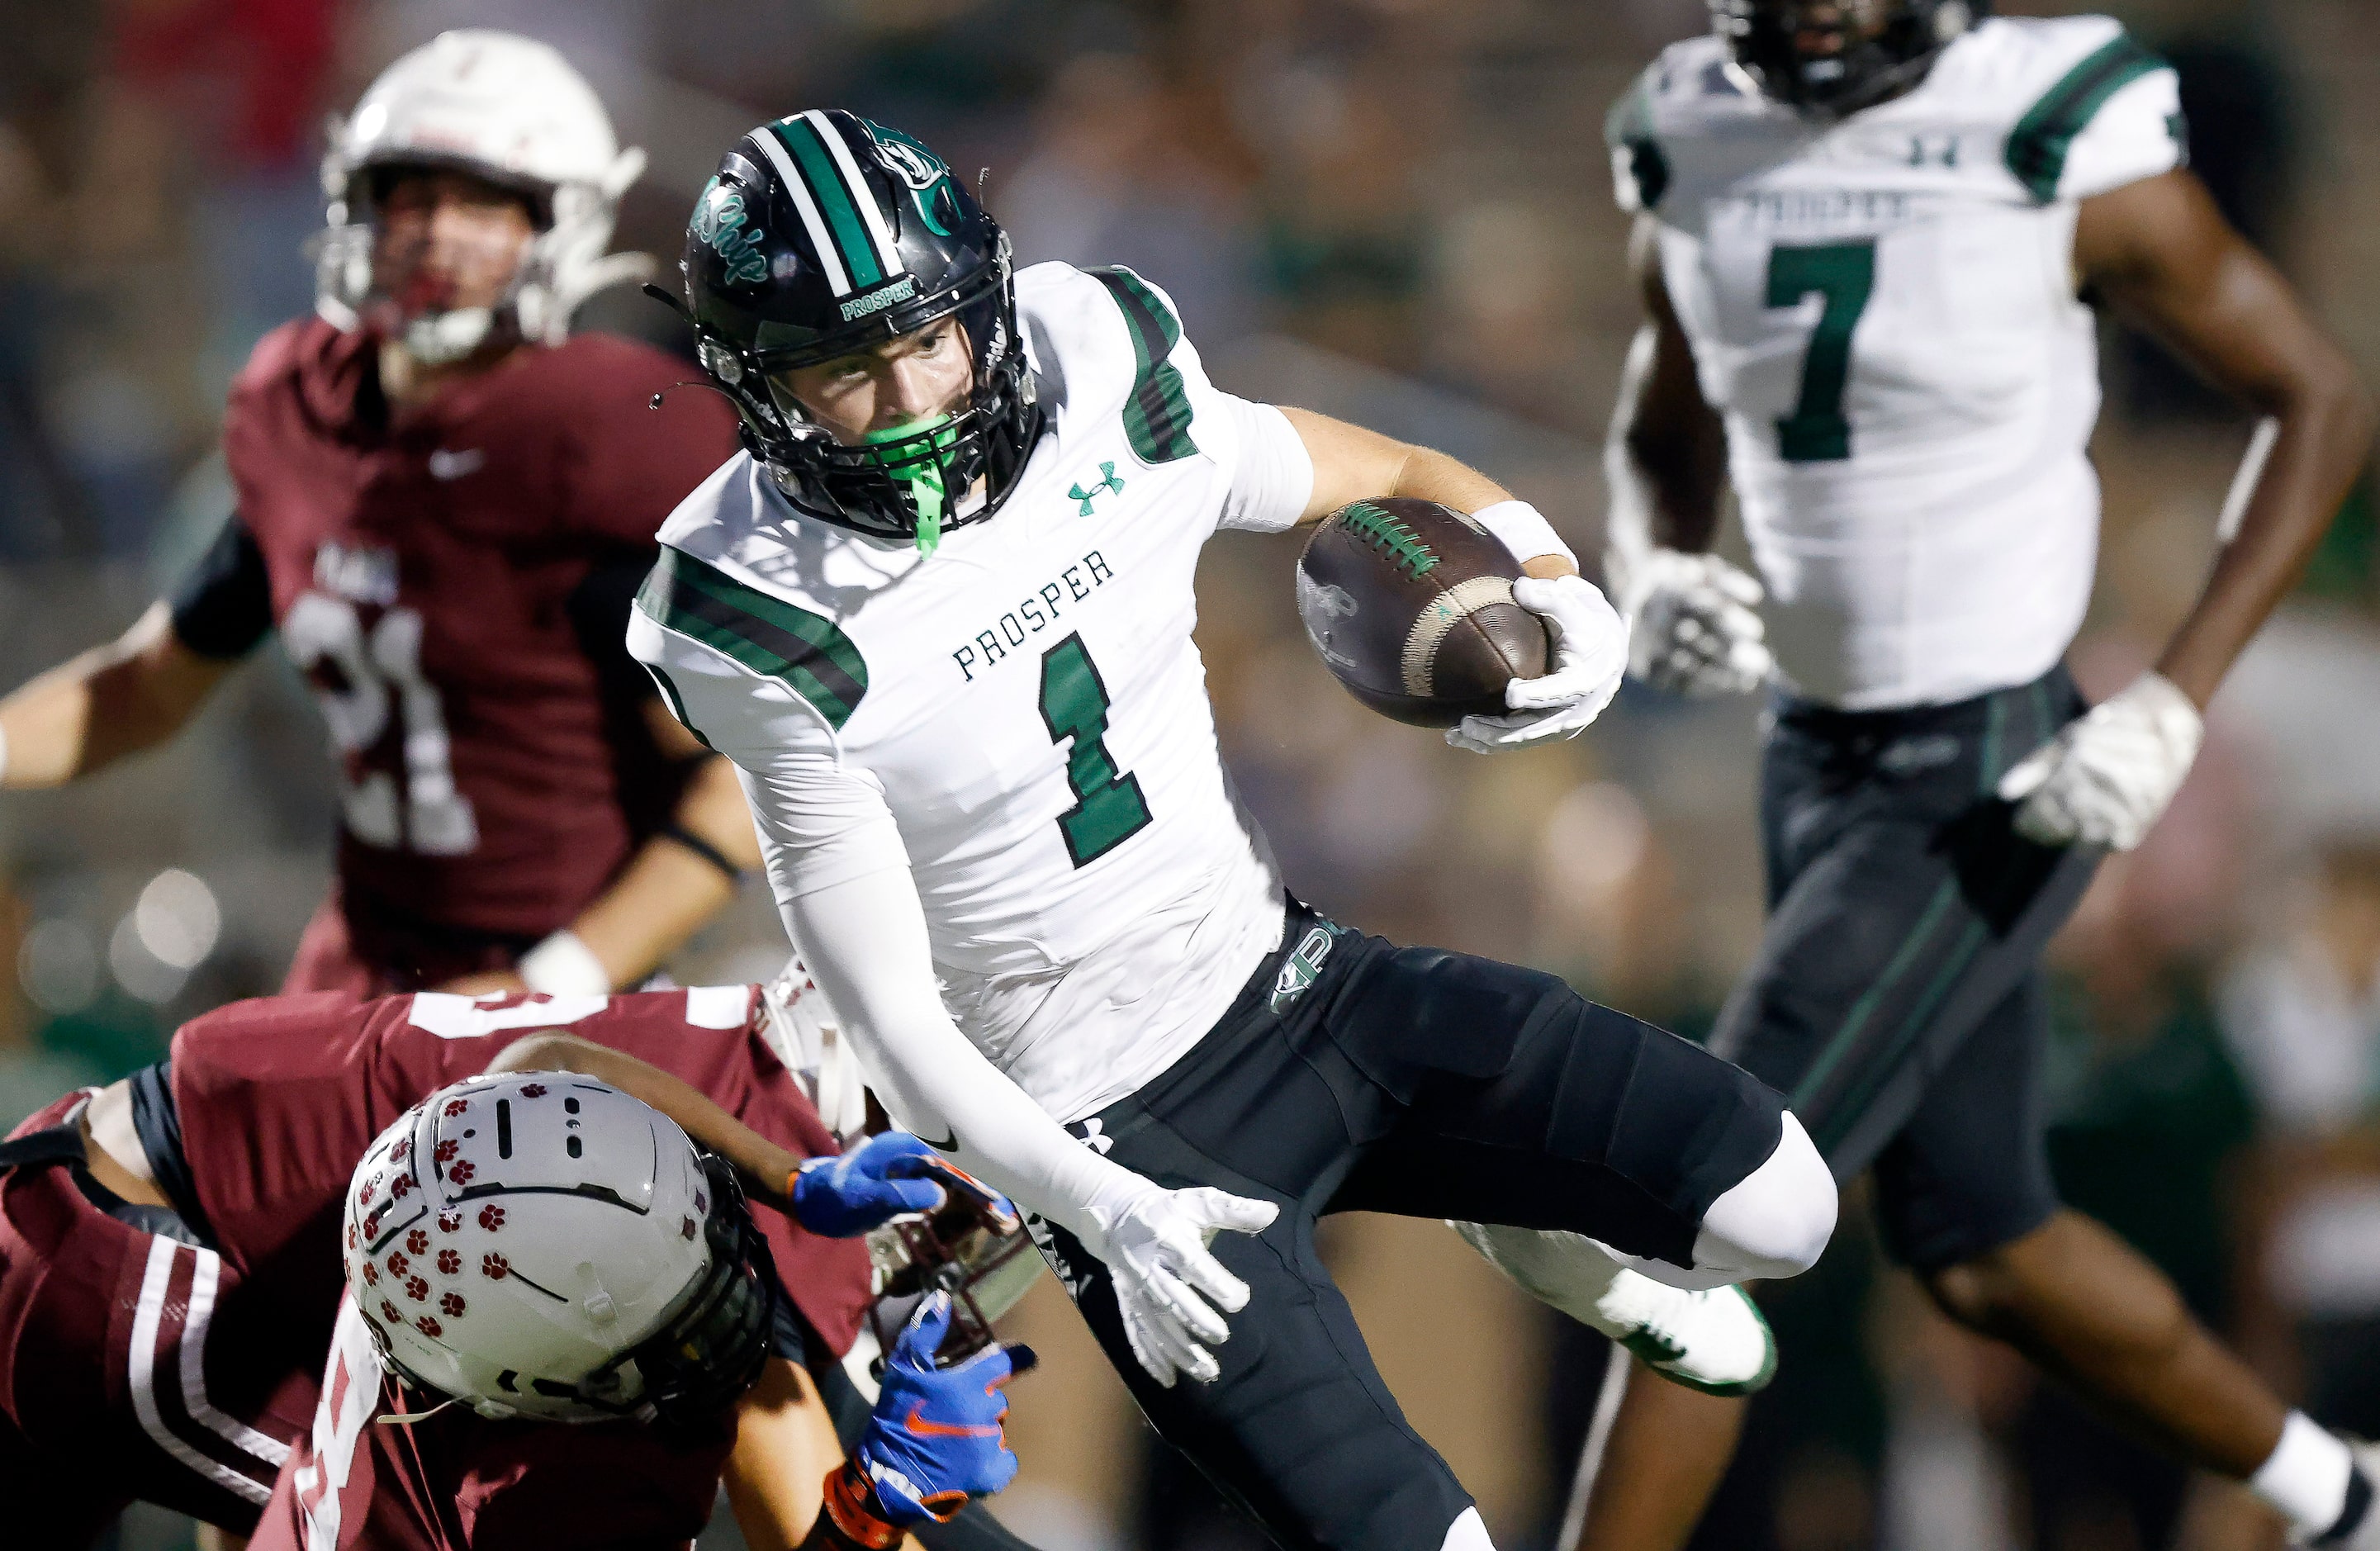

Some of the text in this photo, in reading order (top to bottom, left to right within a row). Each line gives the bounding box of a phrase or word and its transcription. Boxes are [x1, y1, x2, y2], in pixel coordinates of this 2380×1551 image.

[841, 280, 915, 320] PROSPER
[1764, 240, 1879, 463] 7
[952, 549, 1115, 682] PROSPER
[1038, 629, 1154, 870] 1
